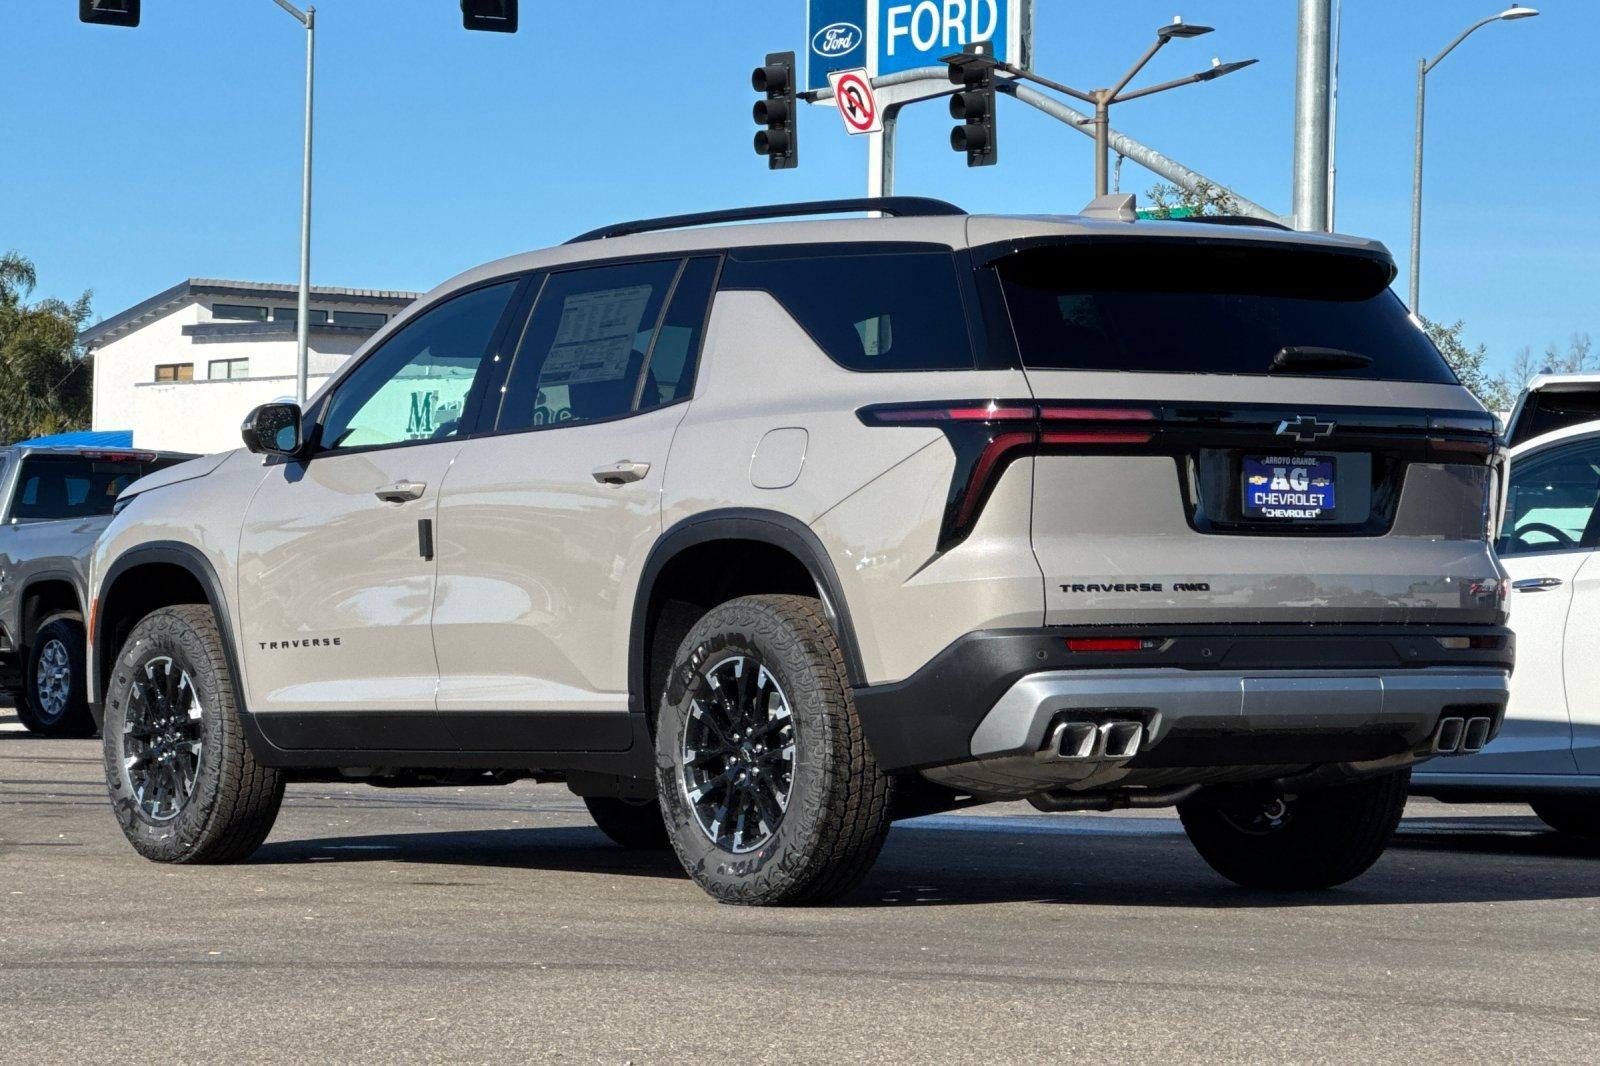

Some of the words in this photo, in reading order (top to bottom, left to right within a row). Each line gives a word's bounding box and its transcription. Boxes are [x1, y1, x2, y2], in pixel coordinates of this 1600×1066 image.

[886, 0, 998, 56] FORD
[823, 28, 852, 51] Ford
[1264, 456, 1291, 465] ARROYO
[1291, 457, 1316, 466] GRANDE
[1270, 467, 1310, 491] AG
[1254, 492, 1325, 506] CHEVROLET
[1265, 508, 1317, 518] CHEVROLET
[1060, 583, 1163, 593] TRAVERSE
[1173, 583, 1211, 592] AWD
[259, 637, 342, 650] TRAVERSE
